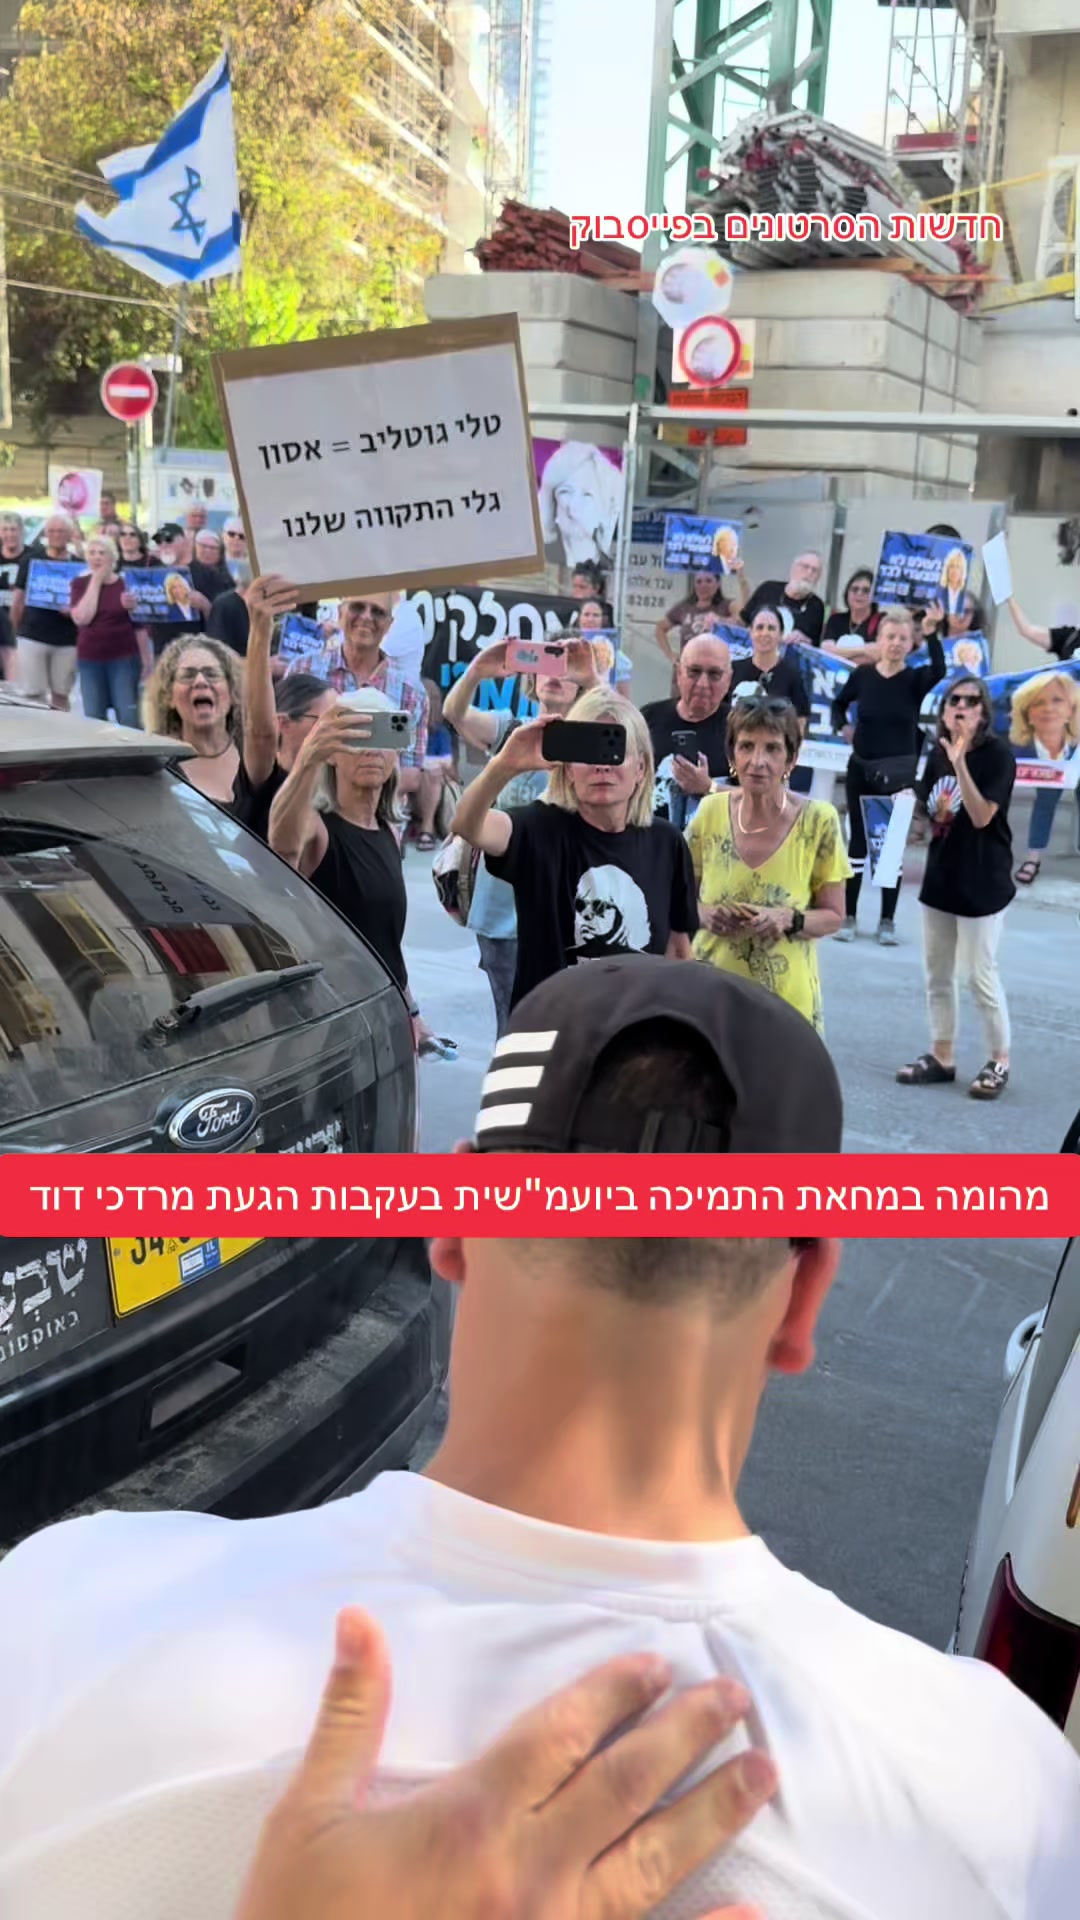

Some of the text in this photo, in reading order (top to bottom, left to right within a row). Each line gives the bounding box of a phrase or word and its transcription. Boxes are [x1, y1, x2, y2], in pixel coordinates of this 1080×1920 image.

[359, 423, 449, 453] גוטליב
[455, 413, 501, 438] טלי
[258, 439, 322, 470] אסון
[282, 490, 501, 538] גלי התקווה שלנו
[197, 1099, 242, 1138] Ford
